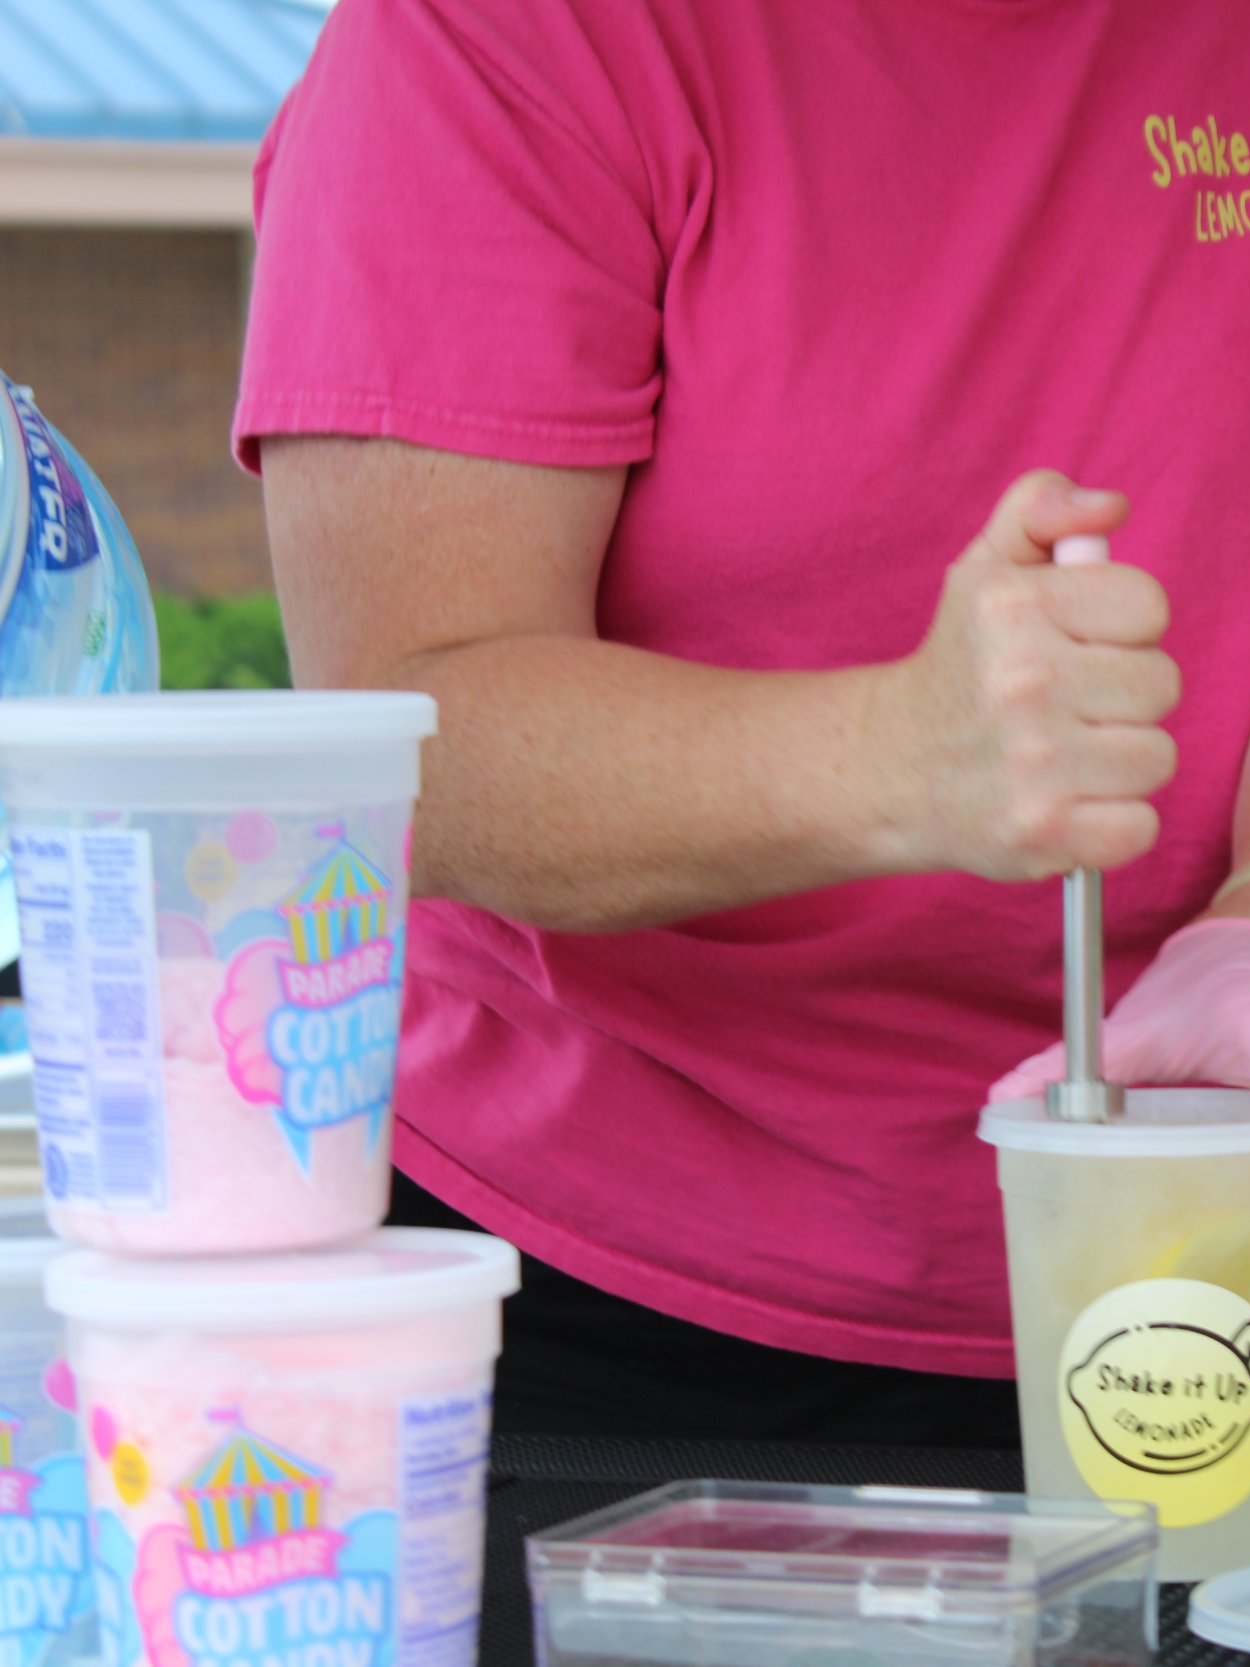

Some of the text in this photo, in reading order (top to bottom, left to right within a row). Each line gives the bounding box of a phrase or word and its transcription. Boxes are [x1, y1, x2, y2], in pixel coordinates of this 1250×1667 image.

[1144, 114, 1250, 188] Shake
[285, 944, 387, 1002] PARADE
[1097, 1364, 1248, 1404] Shake it Up
[1112, 1406, 1215, 1442] LEMONADE
[184, 1533, 331, 1593] PARADE
[177, 1576, 384, 1654] COTTON
